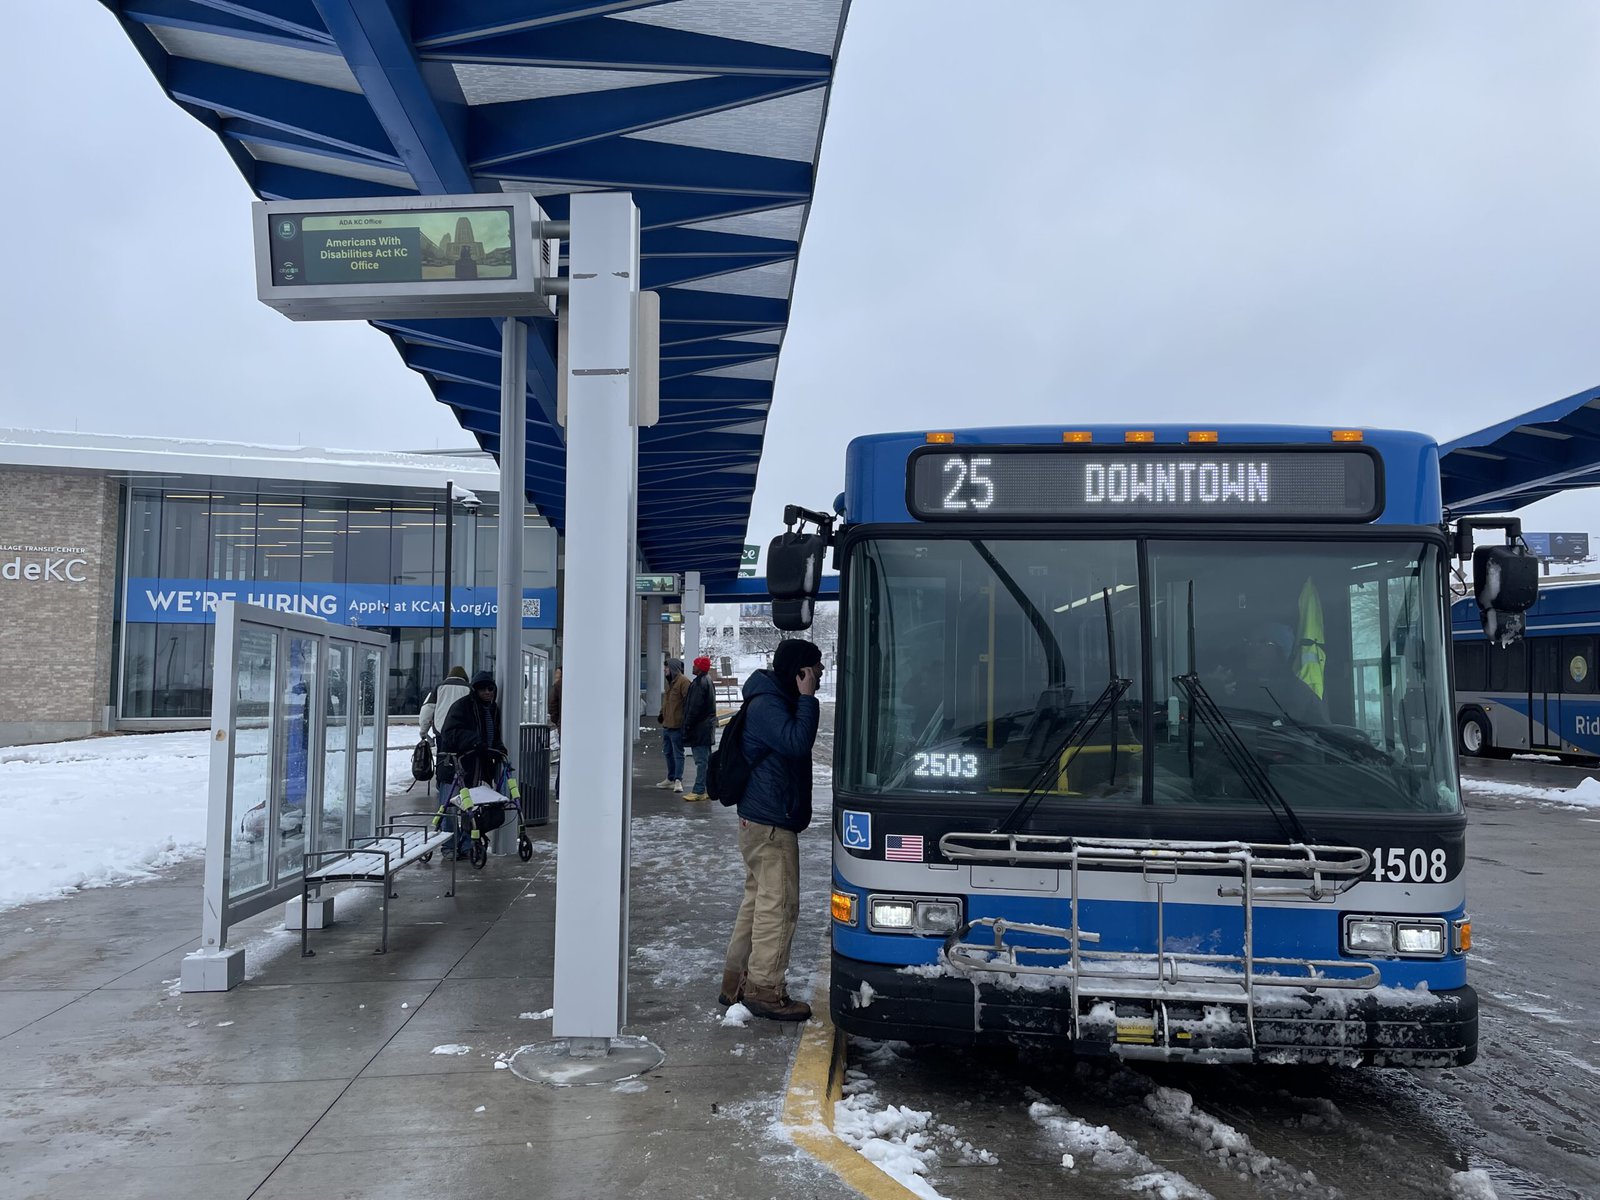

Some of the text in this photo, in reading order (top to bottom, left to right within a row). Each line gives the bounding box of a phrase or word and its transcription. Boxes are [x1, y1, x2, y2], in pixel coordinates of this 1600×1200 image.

[326, 236, 401, 248] Americans With
[320, 247, 408, 260] Disabilities Act KC
[350, 260, 380, 271] Office
[944, 458, 1269, 508] 25 DOWNTOWN
[348, 599, 389, 614] Apply
[394, 602, 407, 612] at
[914, 752, 977, 777] 2503
[1371, 847, 1447, 883] 4508
